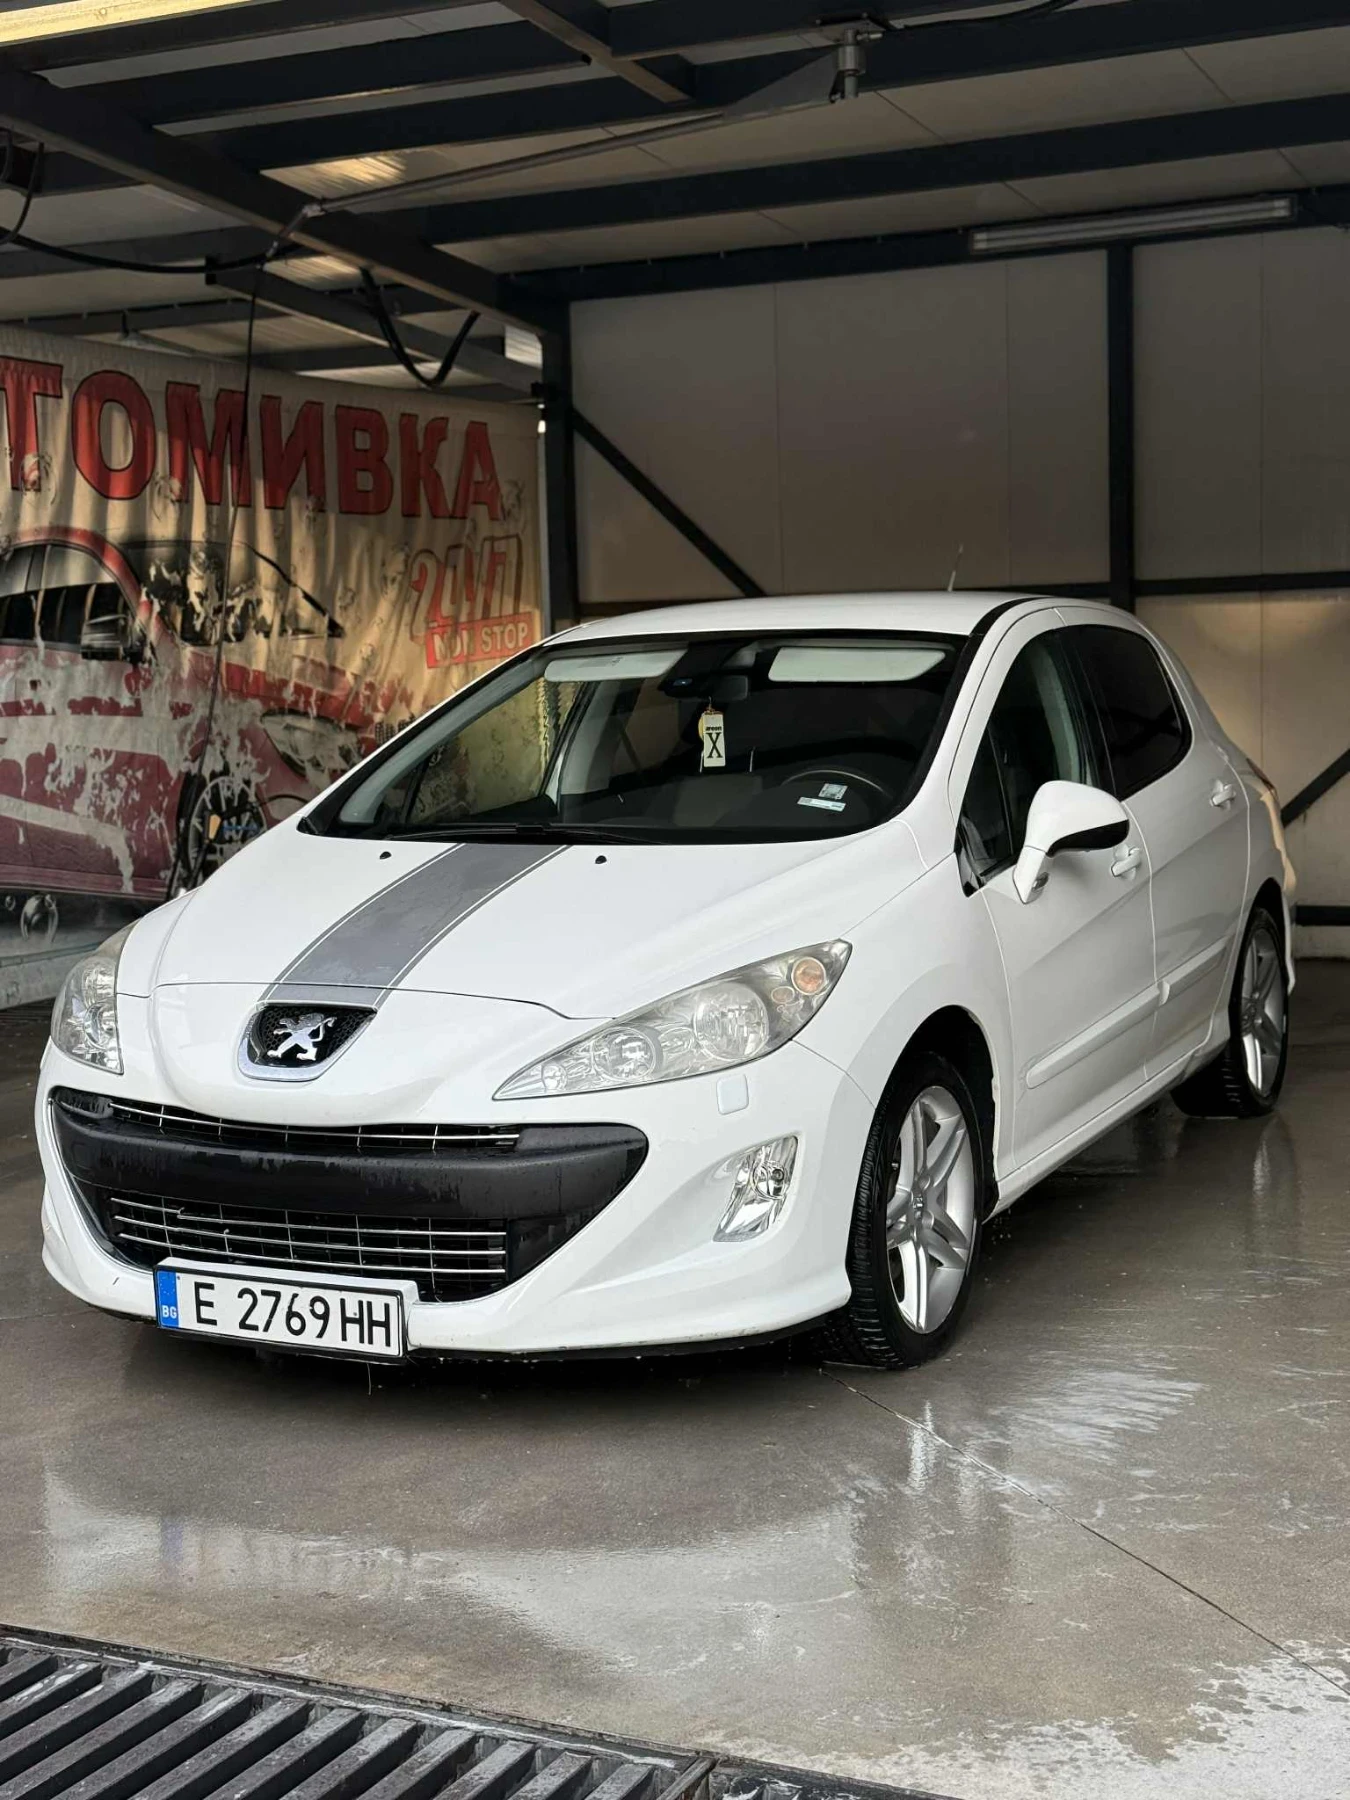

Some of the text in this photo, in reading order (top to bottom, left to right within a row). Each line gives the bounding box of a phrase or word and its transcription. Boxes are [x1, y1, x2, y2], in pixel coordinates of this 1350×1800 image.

[0, 356, 504, 521] ТОМИВКА
[480, 620, 529, 655] STOP
[706, 732, 723, 758] X
[162, 1305, 177, 1319] BG
[194, 1281, 391, 1347] E 2769 HH
